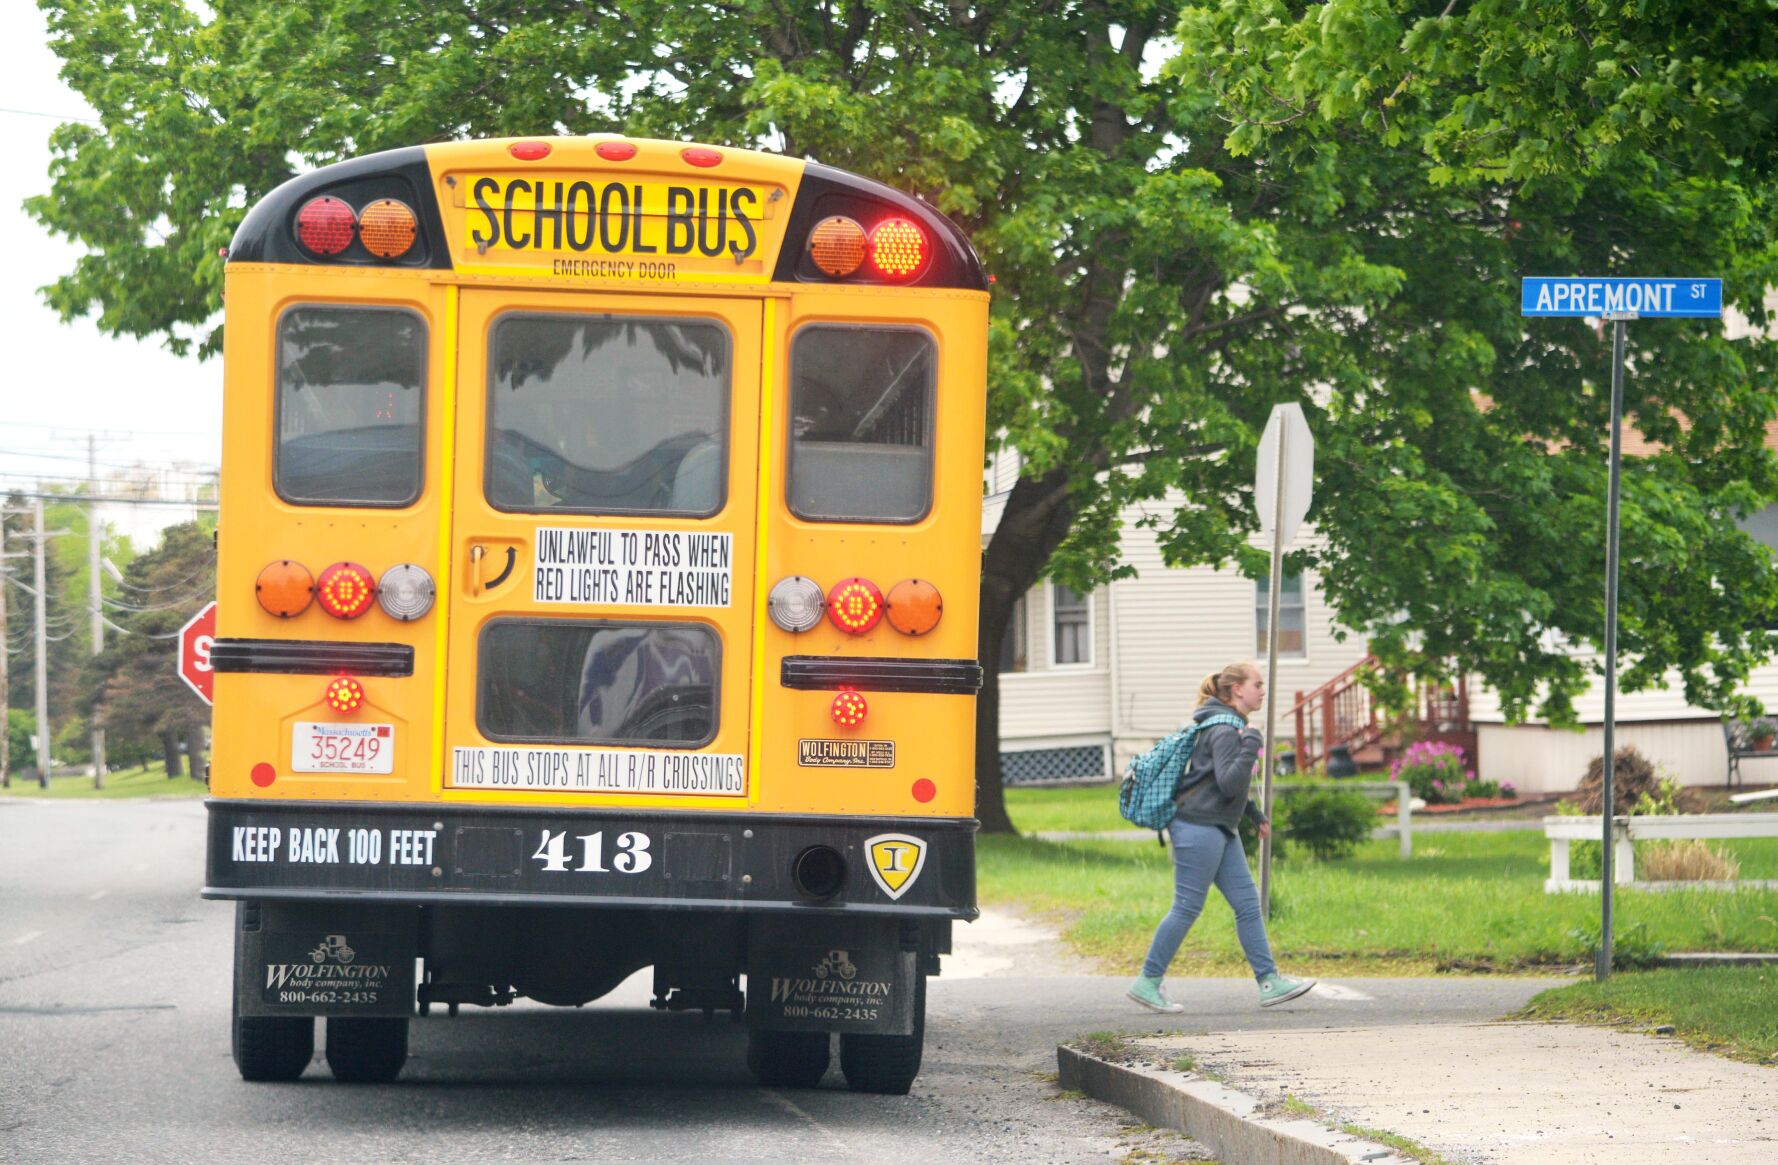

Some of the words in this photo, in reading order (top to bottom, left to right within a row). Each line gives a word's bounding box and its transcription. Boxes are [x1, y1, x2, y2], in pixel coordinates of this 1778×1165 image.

[472, 177, 657, 253] SCHOOL
[666, 186, 757, 258] BUS
[553, 259, 635, 278] EMERGENCY
[638, 262, 676, 280] DOOR
[1535, 283, 1677, 312] APREMONT
[1690, 284, 1707, 299] ST
[538, 530, 615, 565] UNLAWFUL
[621, 532, 638, 565] TO
[645, 533, 681, 567] PASS
[688, 534, 729, 568] WHEN
[536, 567, 563, 600] RED
[570, 568, 618, 602] LIGHTS
[625, 570, 652, 603] ARE
[659, 571, 729, 605] FLASHING
[317, 726, 372, 738] Massachusetts
[311, 735, 380, 761] 35249
[802, 741, 866, 758] WOLFINGTON
[319, 761, 348, 769] SCHOOL
[454, 749, 485, 784] THIS
[492, 751, 519, 785] BUS
[526, 752, 569, 786] STOPS
[576, 753, 592, 787] AT
[599, 754, 620, 788] ALL
[628, 753, 655, 790] R/R
[663, 755, 743, 791] CROSSINGS
[232, 826, 281, 862] KEEP
[288, 827, 340, 863] BACK
[348, 828, 382, 865] 100
[389, 829, 437, 865] FEET
[531, 829, 652, 874] 413
[266, 964, 391, 989] WOLFINGTON
[290, 977, 314, 988] body
[315, 979, 362, 989] company,
[365, 979, 383, 988] inc.
[280, 991, 377, 1003] 800-662-2435
[771, 977, 891, 1003] WOLFINGTON
[794, 993, 816, 1005] body
[818, 995, 864, 1006] company,
[866, 996, 884, 1005] inc.
[783, 1005, 878, 1021] 800-662-2435
